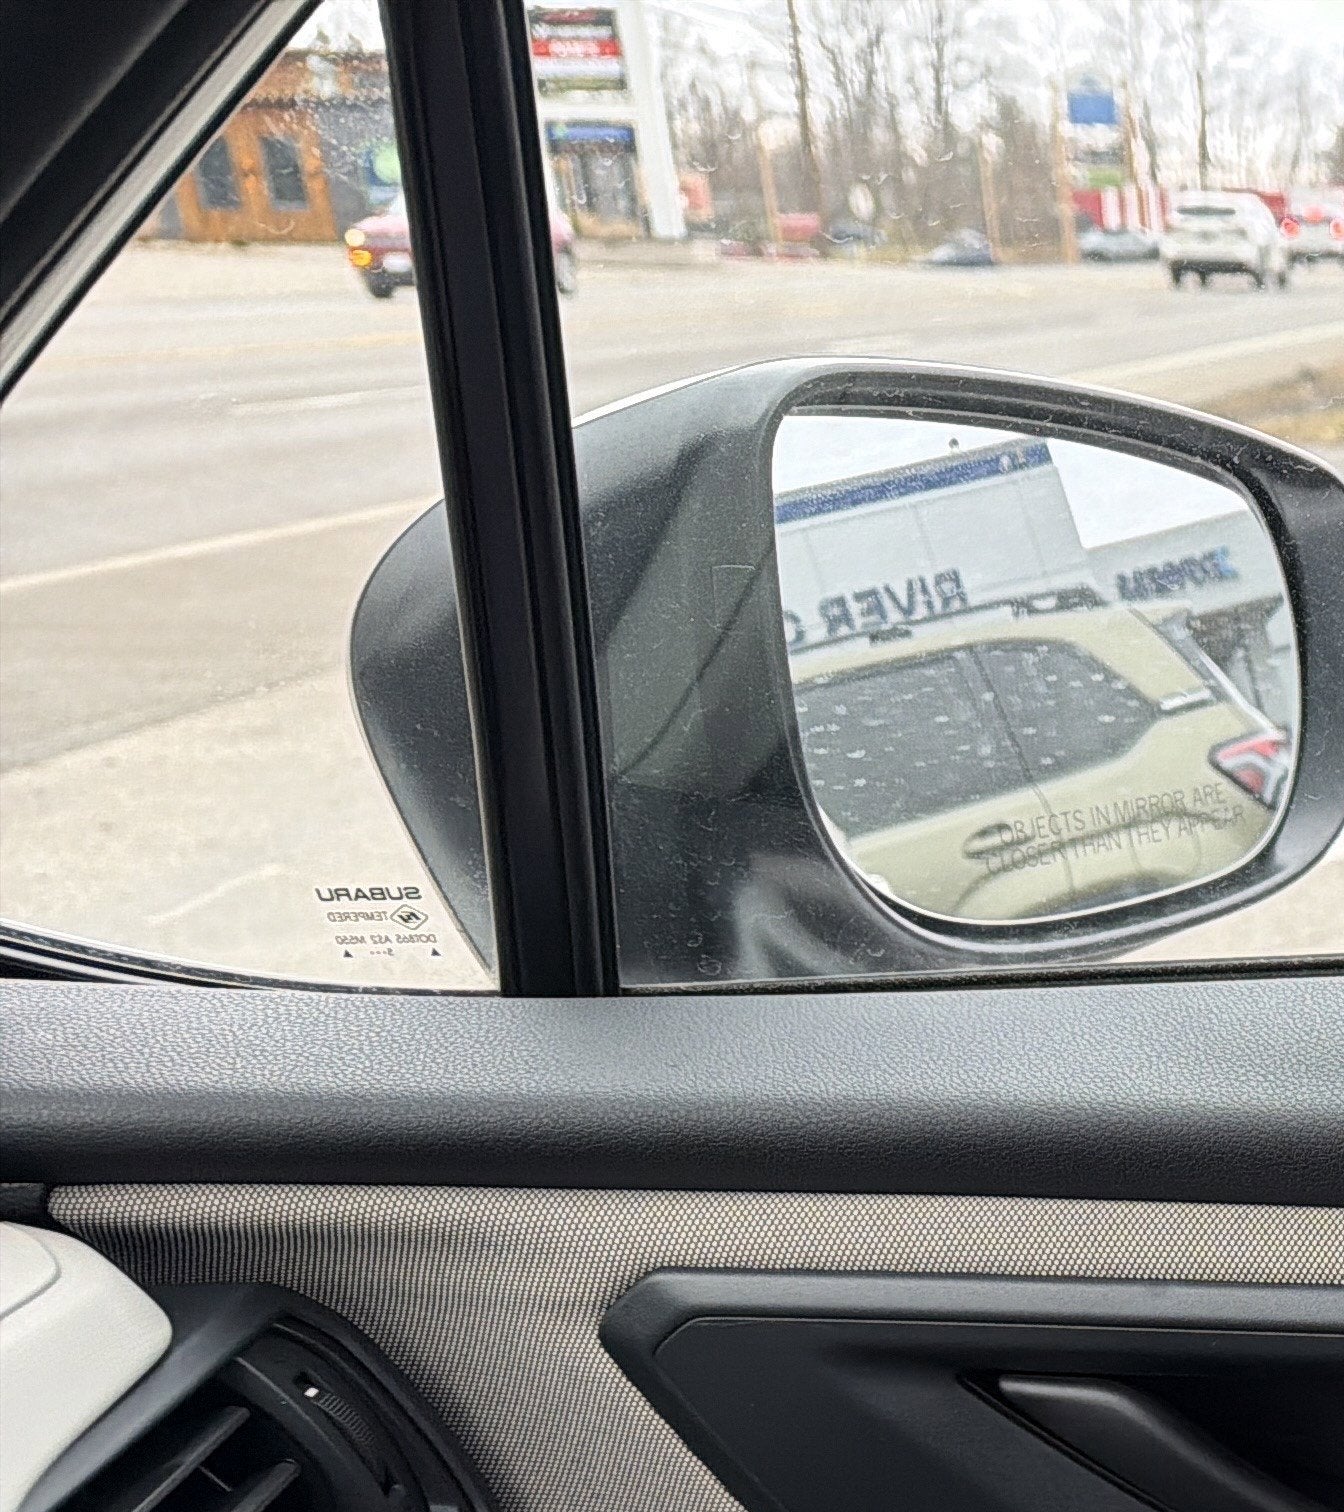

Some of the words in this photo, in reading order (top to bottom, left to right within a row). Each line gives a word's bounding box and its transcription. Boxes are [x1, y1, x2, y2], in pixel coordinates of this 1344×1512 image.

[985, 841, 1067, 875] CLOSER
[1068, 831, 1122, 860] THAN
[1125, 820, 1173, 848] THEY
[1176, 803, 1246, 839] APPEAR
[1000, 809, 1086, 844] OBJECTS
[1090, 804, 1111, 828] IN
[1113, 790, 1187, 824] MIRROR
[1192, 782, 1228, 808] ARE
